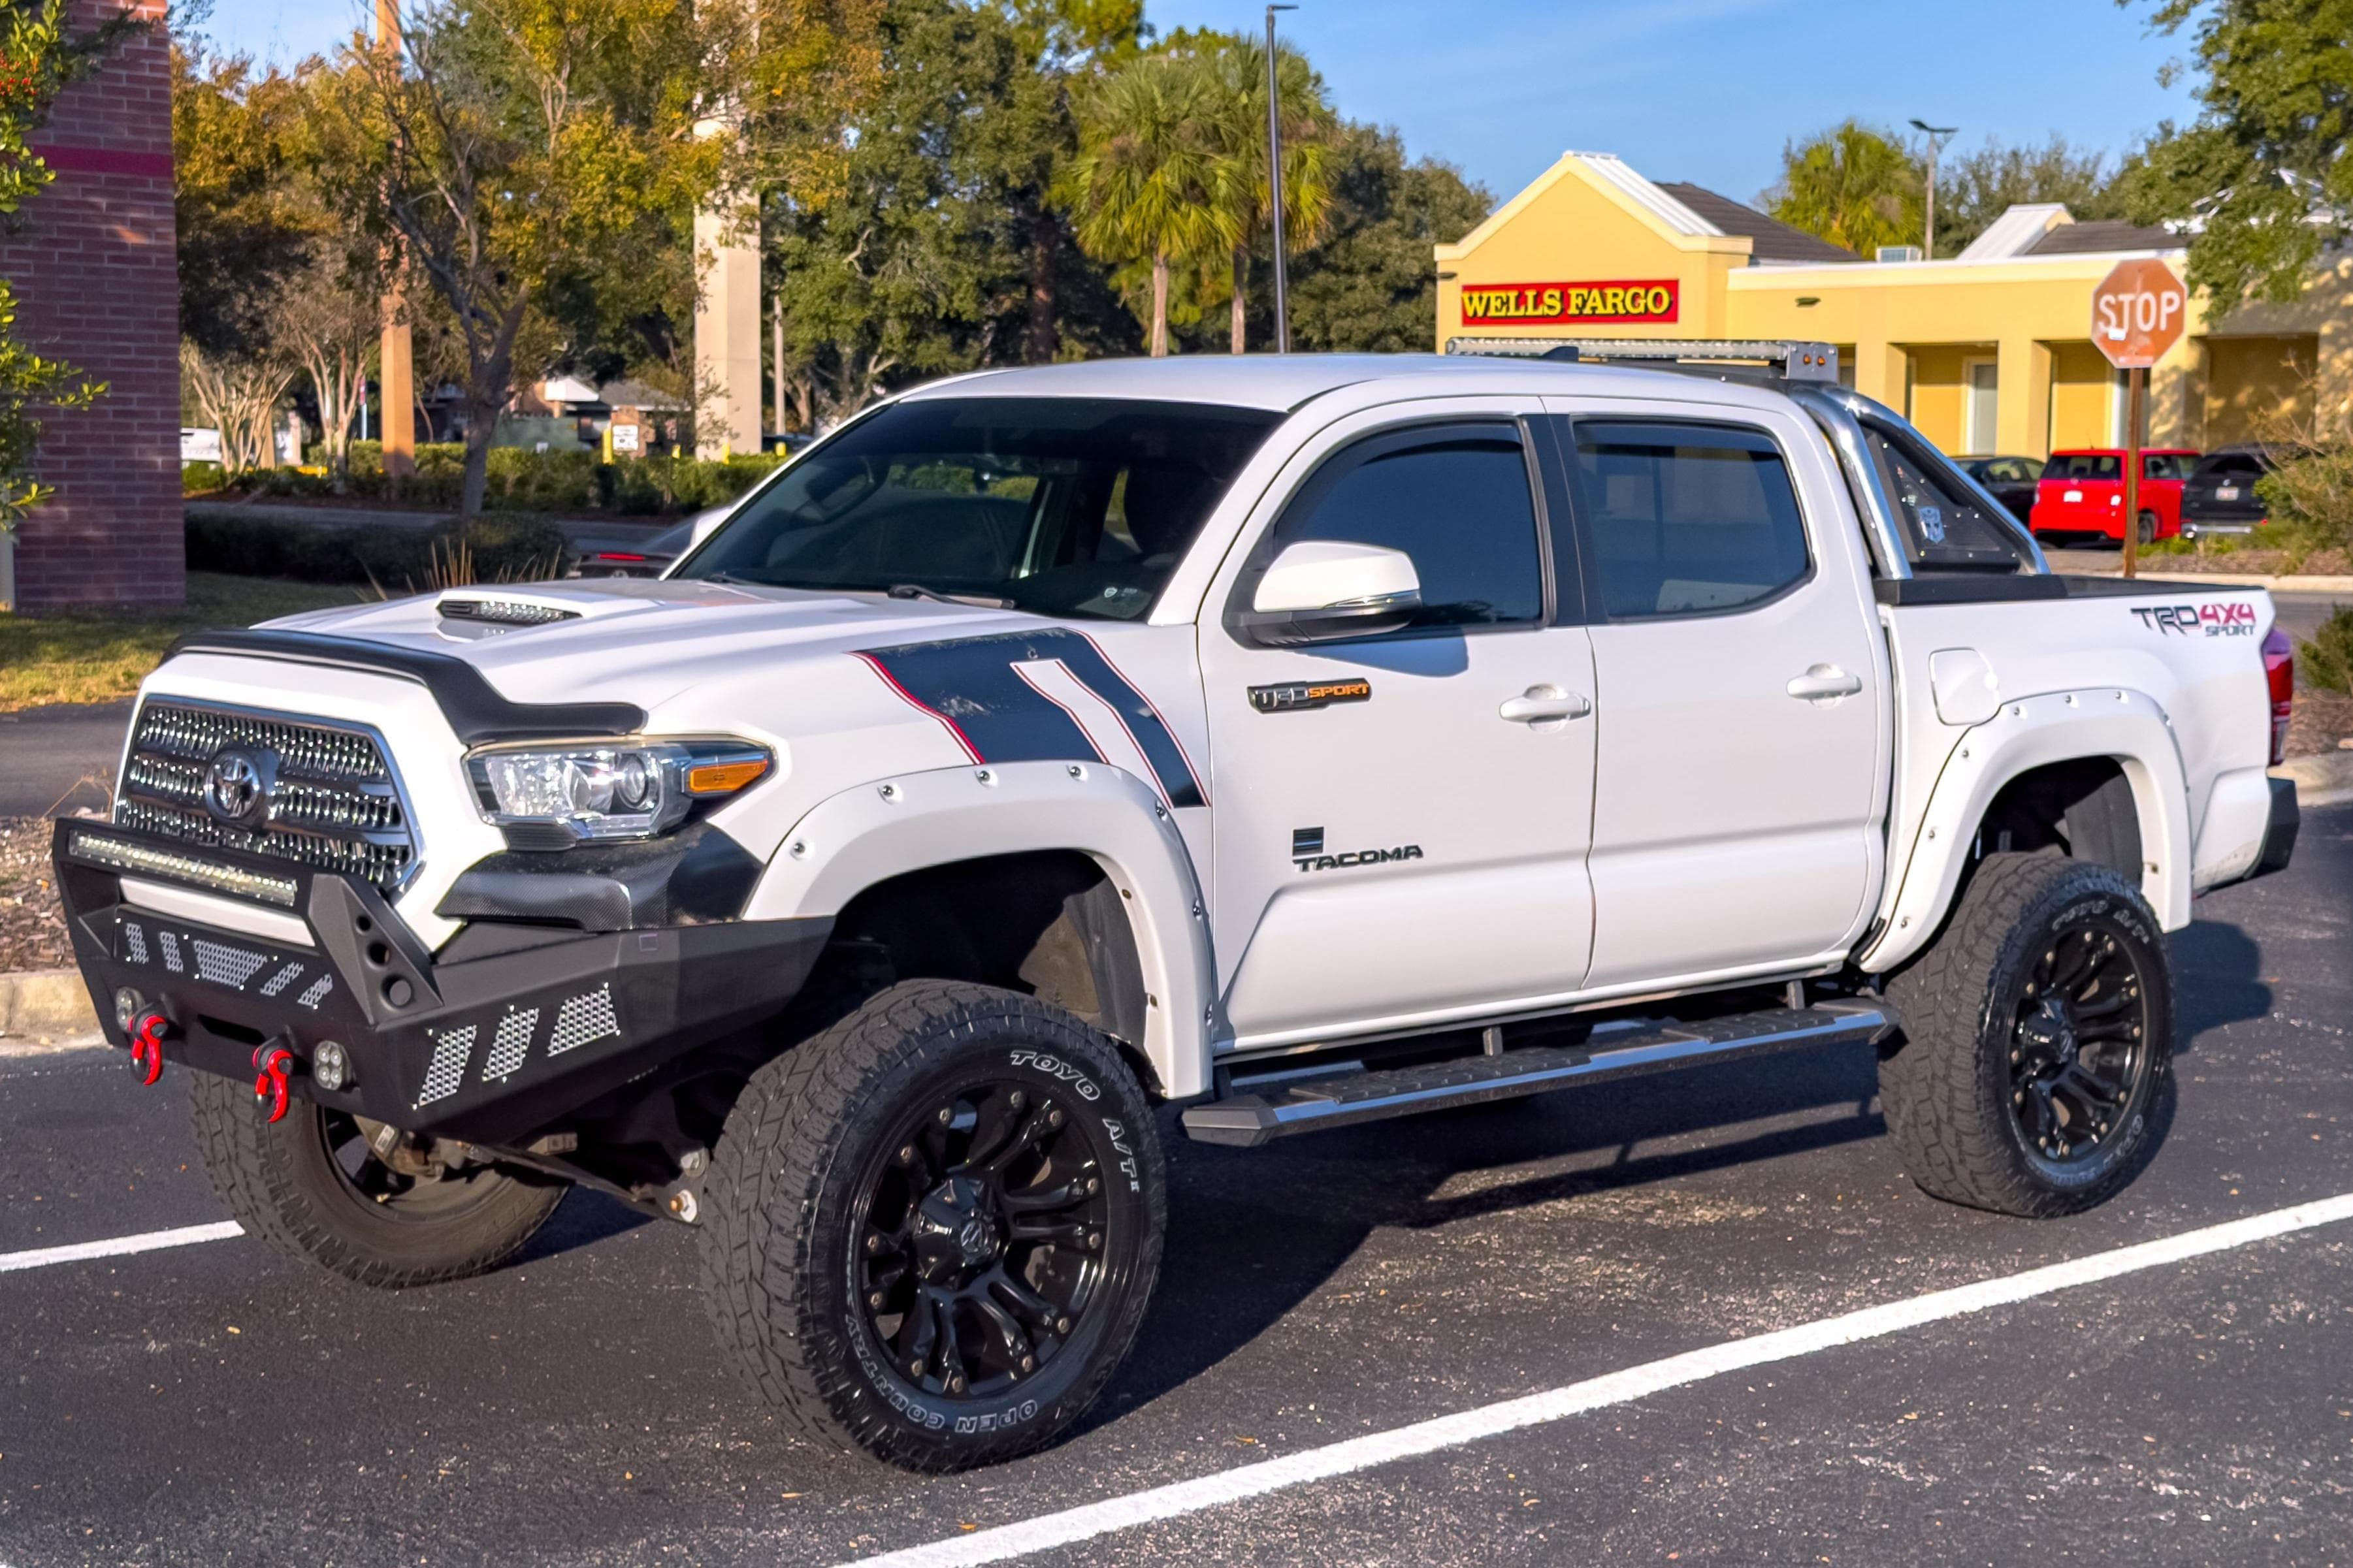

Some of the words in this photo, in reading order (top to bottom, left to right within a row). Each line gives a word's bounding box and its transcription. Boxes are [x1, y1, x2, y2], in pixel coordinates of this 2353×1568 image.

[1462, 289, 1562, 317] WELLS
[1567, 286, 1670, 315] FARGO
[2098, 291, 2181, 332] STOP
[2130, 605, 2201, 636] TRD
[2205, 625, 2254, 637] SPORT
[1308, 682, 1369, 698] SPORT
[1292, 844, 1423, 872] TACOMA
[1010, 1049, 1100, 1100] TOYO
[845, 1313, 945, 1430] COUNTRY
[954, 1399, 1038, 1433] OPEN
